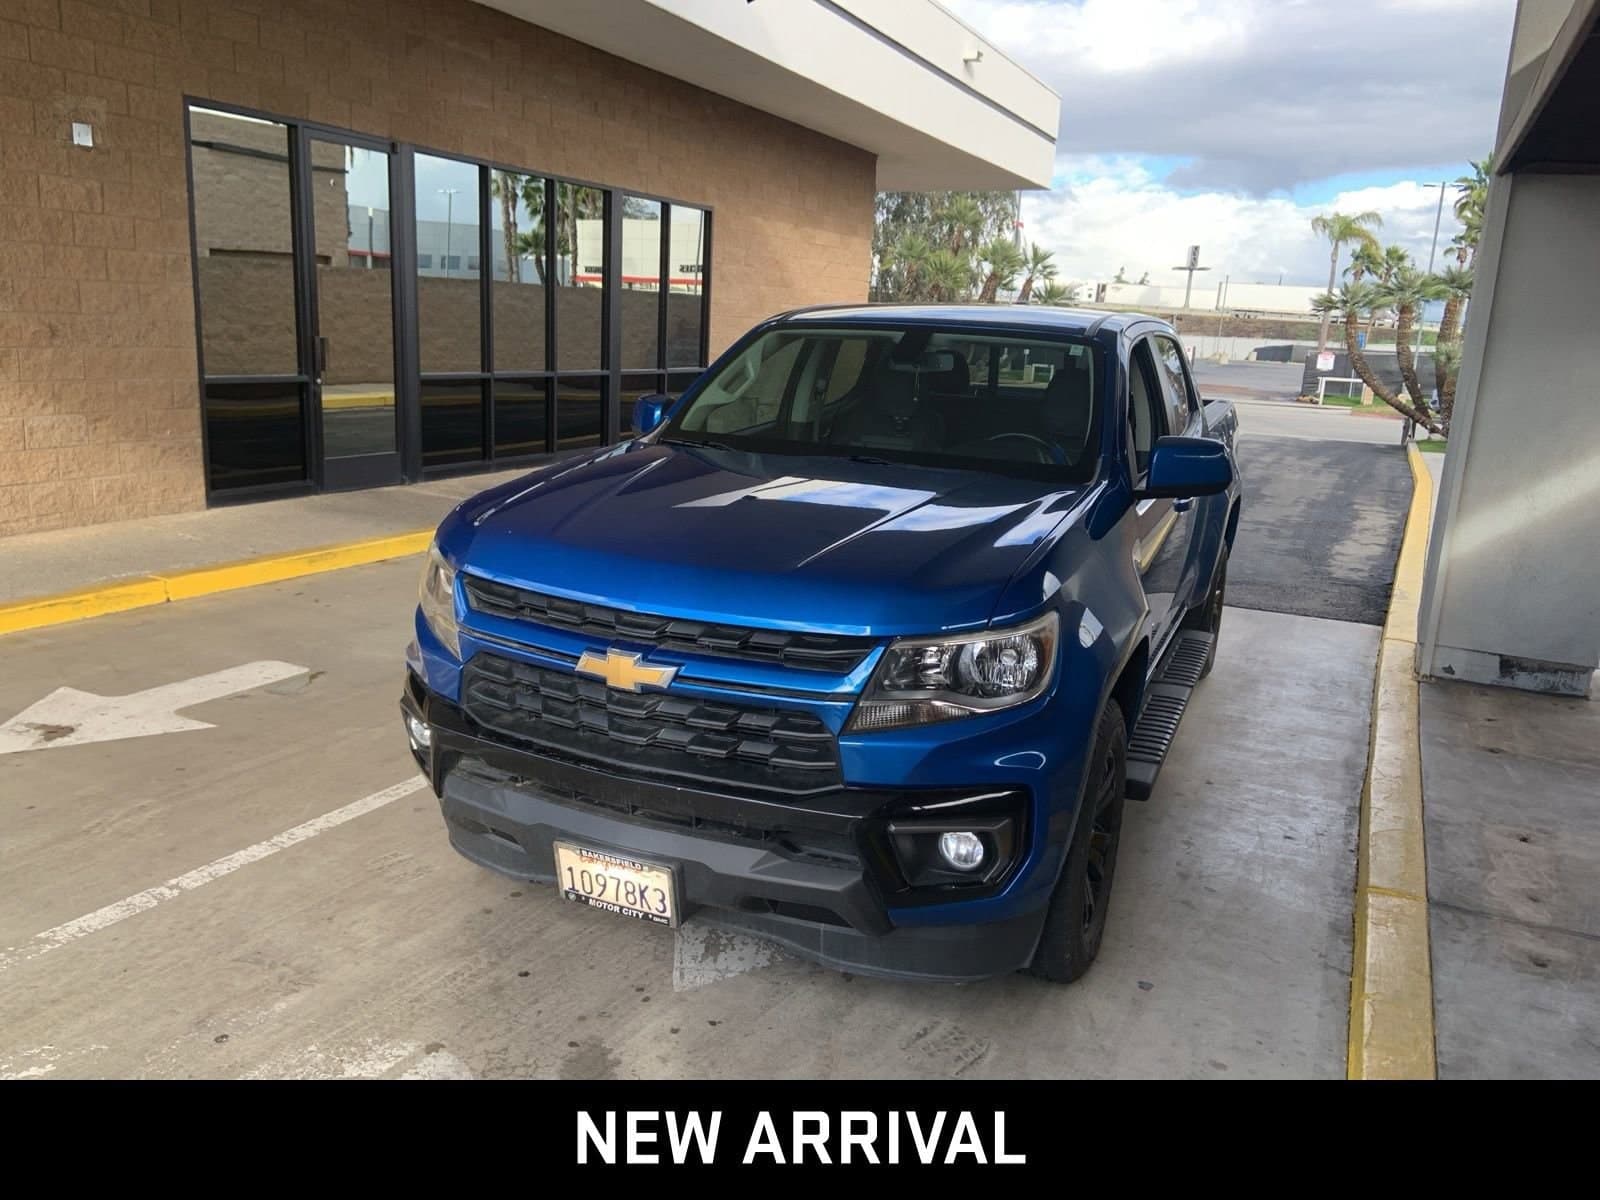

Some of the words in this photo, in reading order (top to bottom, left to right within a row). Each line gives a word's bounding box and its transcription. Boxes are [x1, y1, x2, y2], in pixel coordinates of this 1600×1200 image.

[566, 866, 668, 914] 10978K3
[588, 898, 620, 913] MOTOR
[622, 908, 645, 919] CITY
